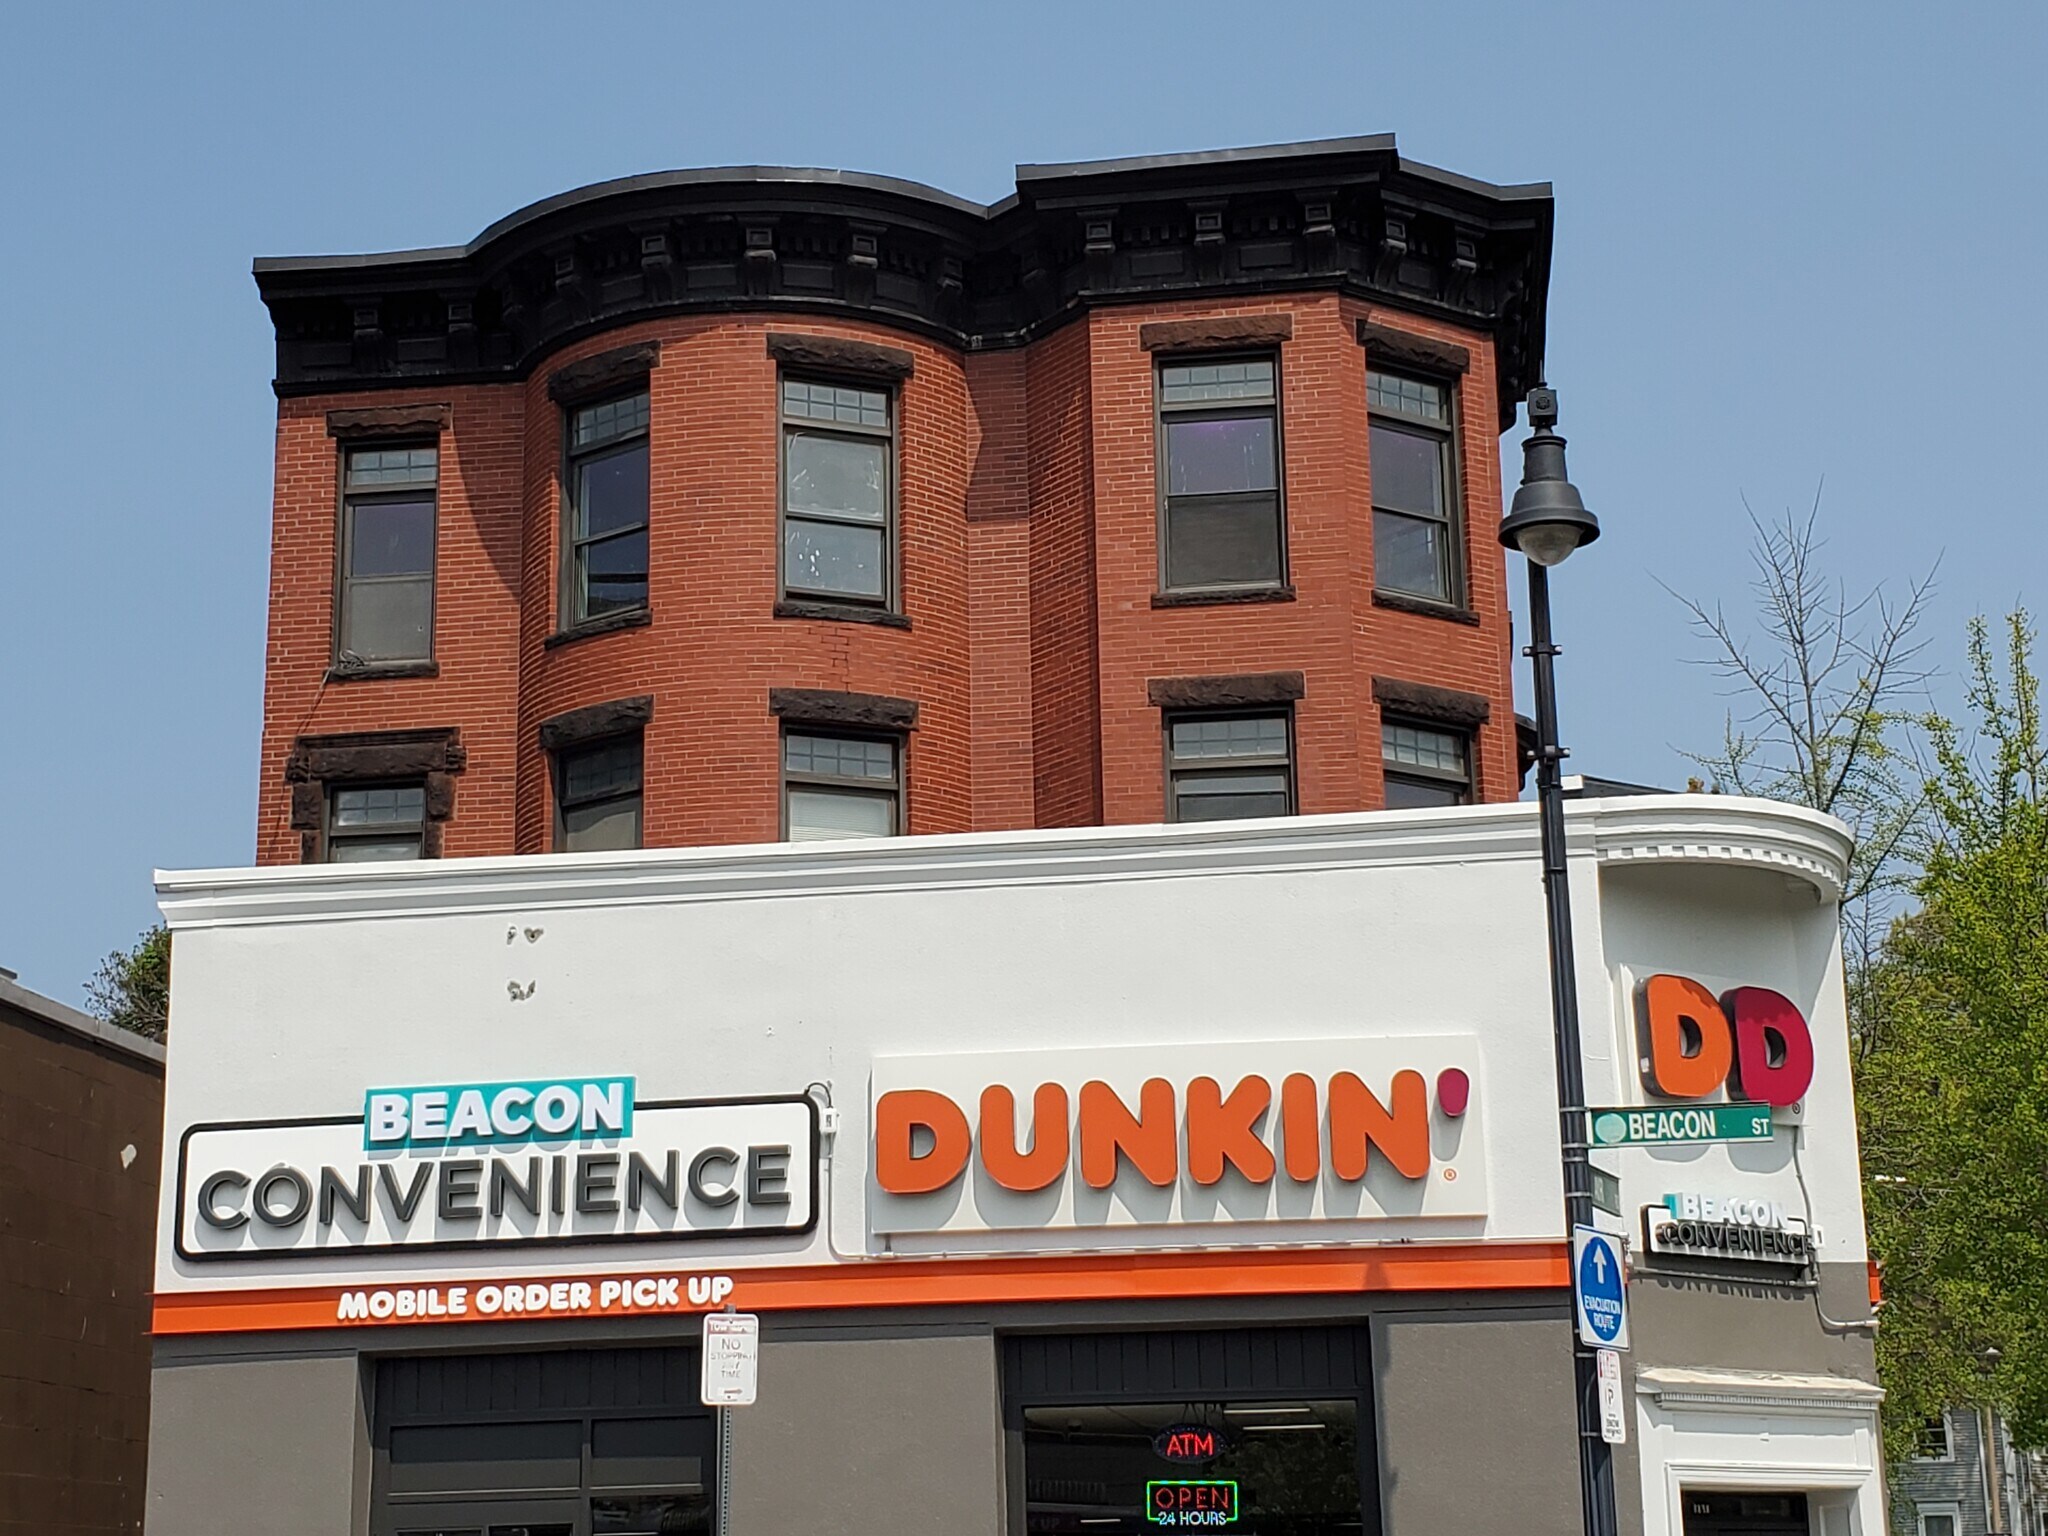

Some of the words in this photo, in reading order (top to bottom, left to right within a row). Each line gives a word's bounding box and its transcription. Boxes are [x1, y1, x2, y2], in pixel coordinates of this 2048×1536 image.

[1636, 973, 1814, 1106] DD
[368, 1081, 625, 1143] BEACON
[1628, 1111, 1716, 1140] BEACON
[1751, 1117, 1769, 1135] ST
[876, 1067, 1470, 1195] DUNKIN'
[197, 1143, 792, 1230] CONVENIENCE
[1681, 1192, 1789, 1229] BEACON
[1657, 1221, 1816, 1256] CONVENIENCE
[336, 1286, 468, 1320] MOBILE
[476, 1281, 592, 1314] ORDER
[600, 1277, 680, 1309] PICK
[687, 1276, 734, 1305] UP
[1583, 1295, 1621, 1315] EVACUATION
[1593, 1312, 1616, 1330] ROUTE
[721, 1338, 741, 1350] NO
[1167, 1432, 1214, 1457] ATM
[1155, 1487, 1229, 1509] OPEN
[1159, 1511, 1176, 1526] 24
[1180, 1511, 1227, 1526] HOURS
